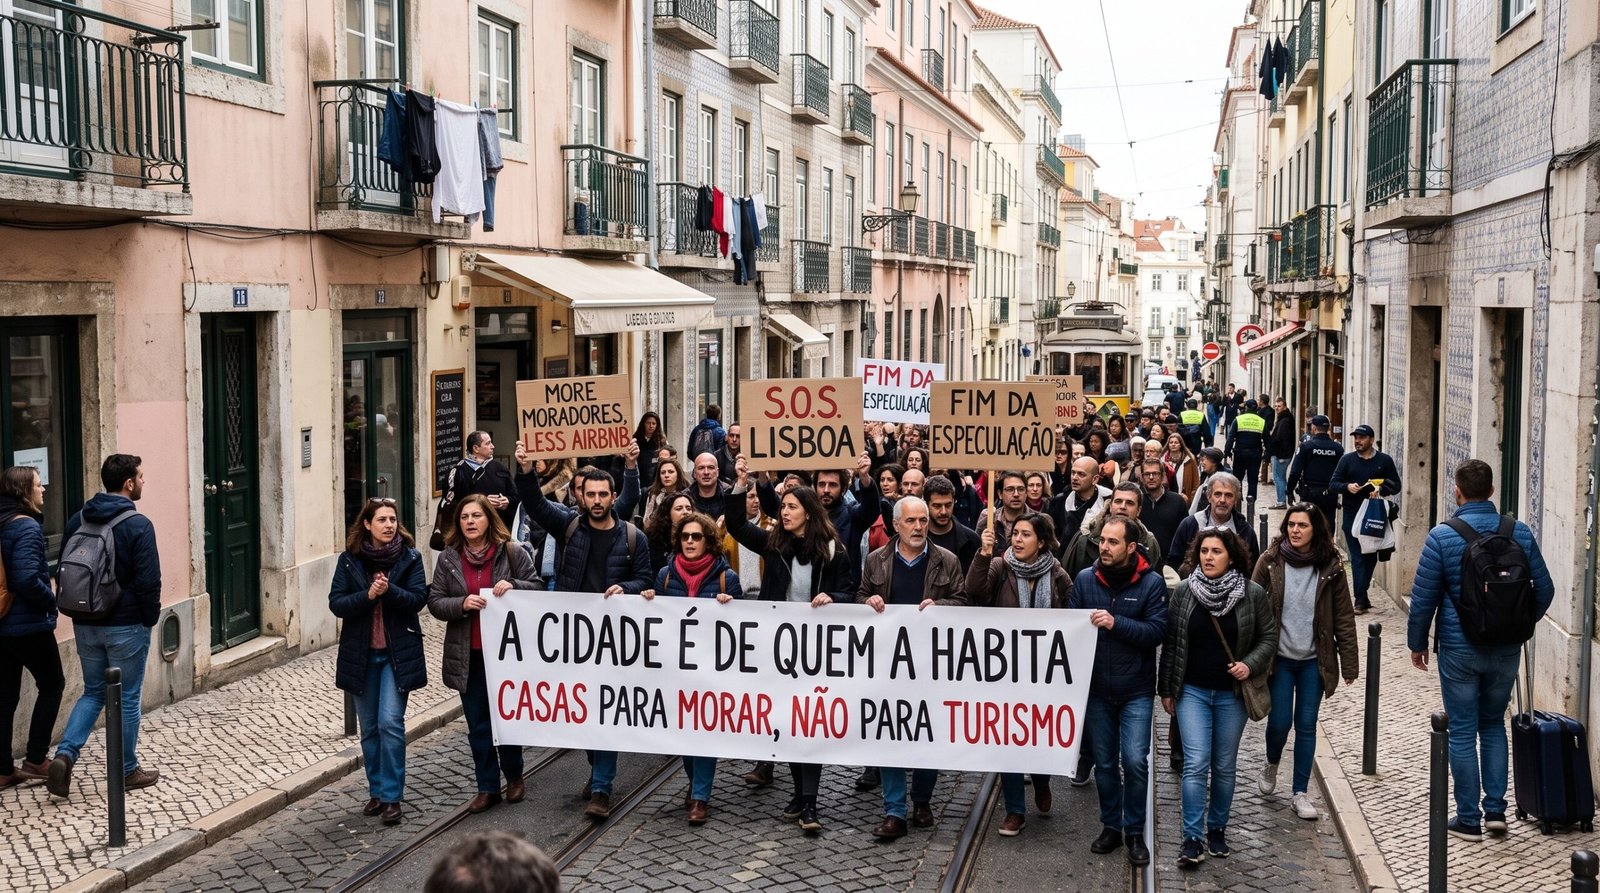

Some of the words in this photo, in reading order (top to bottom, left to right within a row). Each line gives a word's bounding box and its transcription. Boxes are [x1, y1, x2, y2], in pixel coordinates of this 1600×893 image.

[863, 364, 901, 387] FIM
[910, 368, 935, 389] DA
[545, 382, 598, 404] MORE
[763, 385, 842, 420] S.O.S.
[951, 389, 996, 417] FIM
[1007, 390, 1039, 418] DA
[522, 403, 628, 429] MORADORES,
[1055, 405, 1078, 418] BNB
[524, 431, 567, 454] LESS
[572, 426, 631, 451] AIRBNB
[751, 425, 857, 459] LISBOA
[935, 421, 1054, 461] ESPECULAÇÃO
[498, 611, 524, 662] A
[536, 611, 664, 670] CIDADE
[679, 605, 700, 671] É
[715, 620, 759, 674] DE
[773, 622, 875, 679] QUEM
[890, 626, 917, 681] A
[931, 627, 1074, 685] HABITA
[497, 679, 588, 725] CASAS
[599, 685, 669, 729] PARA
[678, 690, 781, 743] MORAR,
[791, 686, 849, 740] NÃO
[860, 698, 934, 743] PARA
[943, 700, 1076, 749] TURISMO
